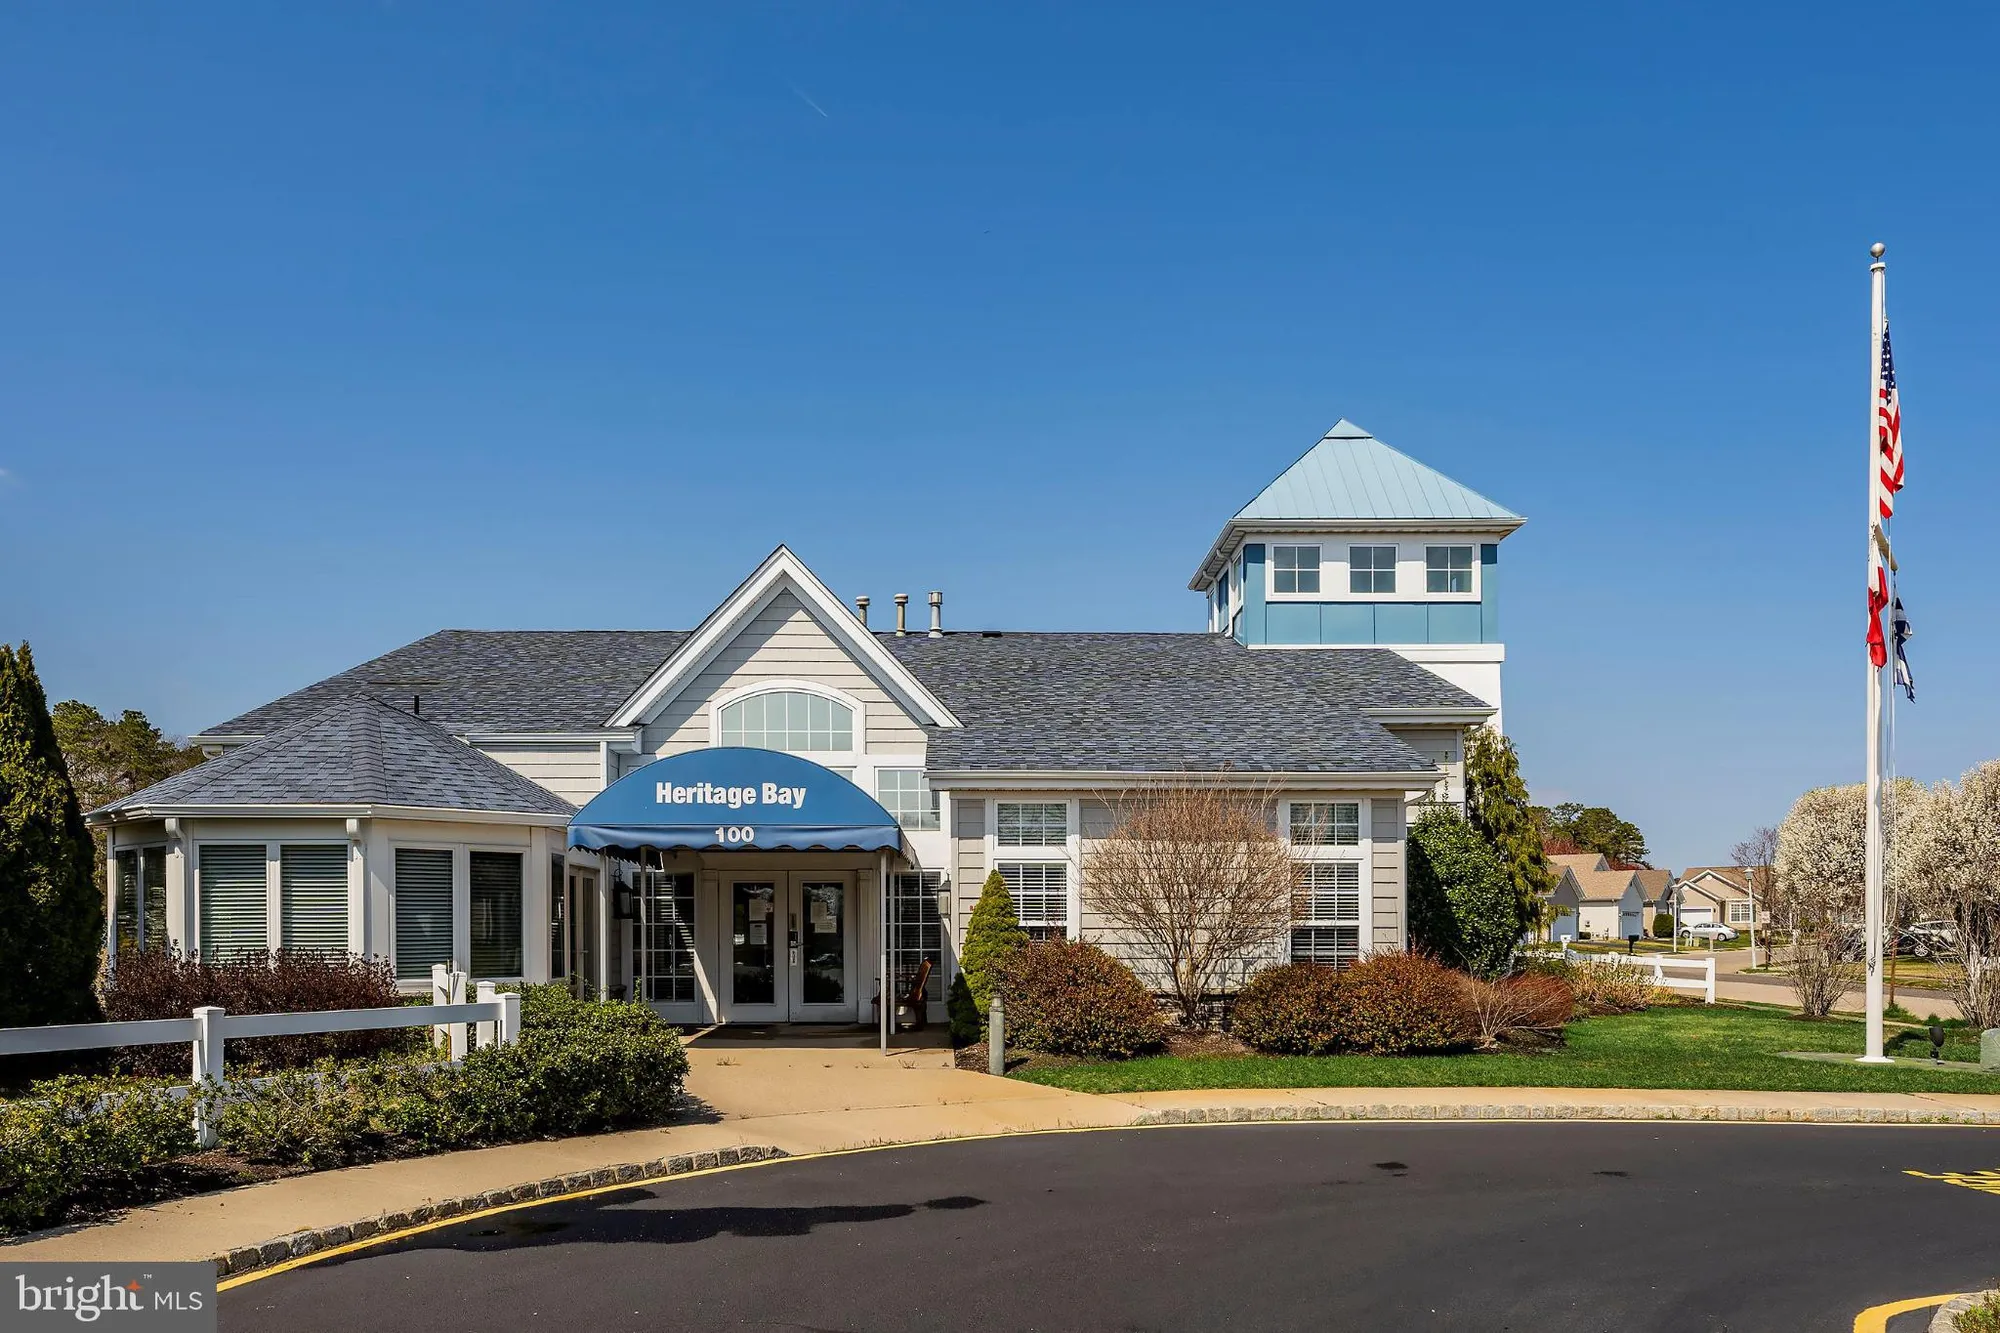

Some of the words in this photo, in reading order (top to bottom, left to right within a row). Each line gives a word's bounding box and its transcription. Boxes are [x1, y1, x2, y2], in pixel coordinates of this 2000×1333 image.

[655, 781, 757, 809] Heritage
[761, 782, 807, 809] Bay
[715, 826, 755, 843] 100
